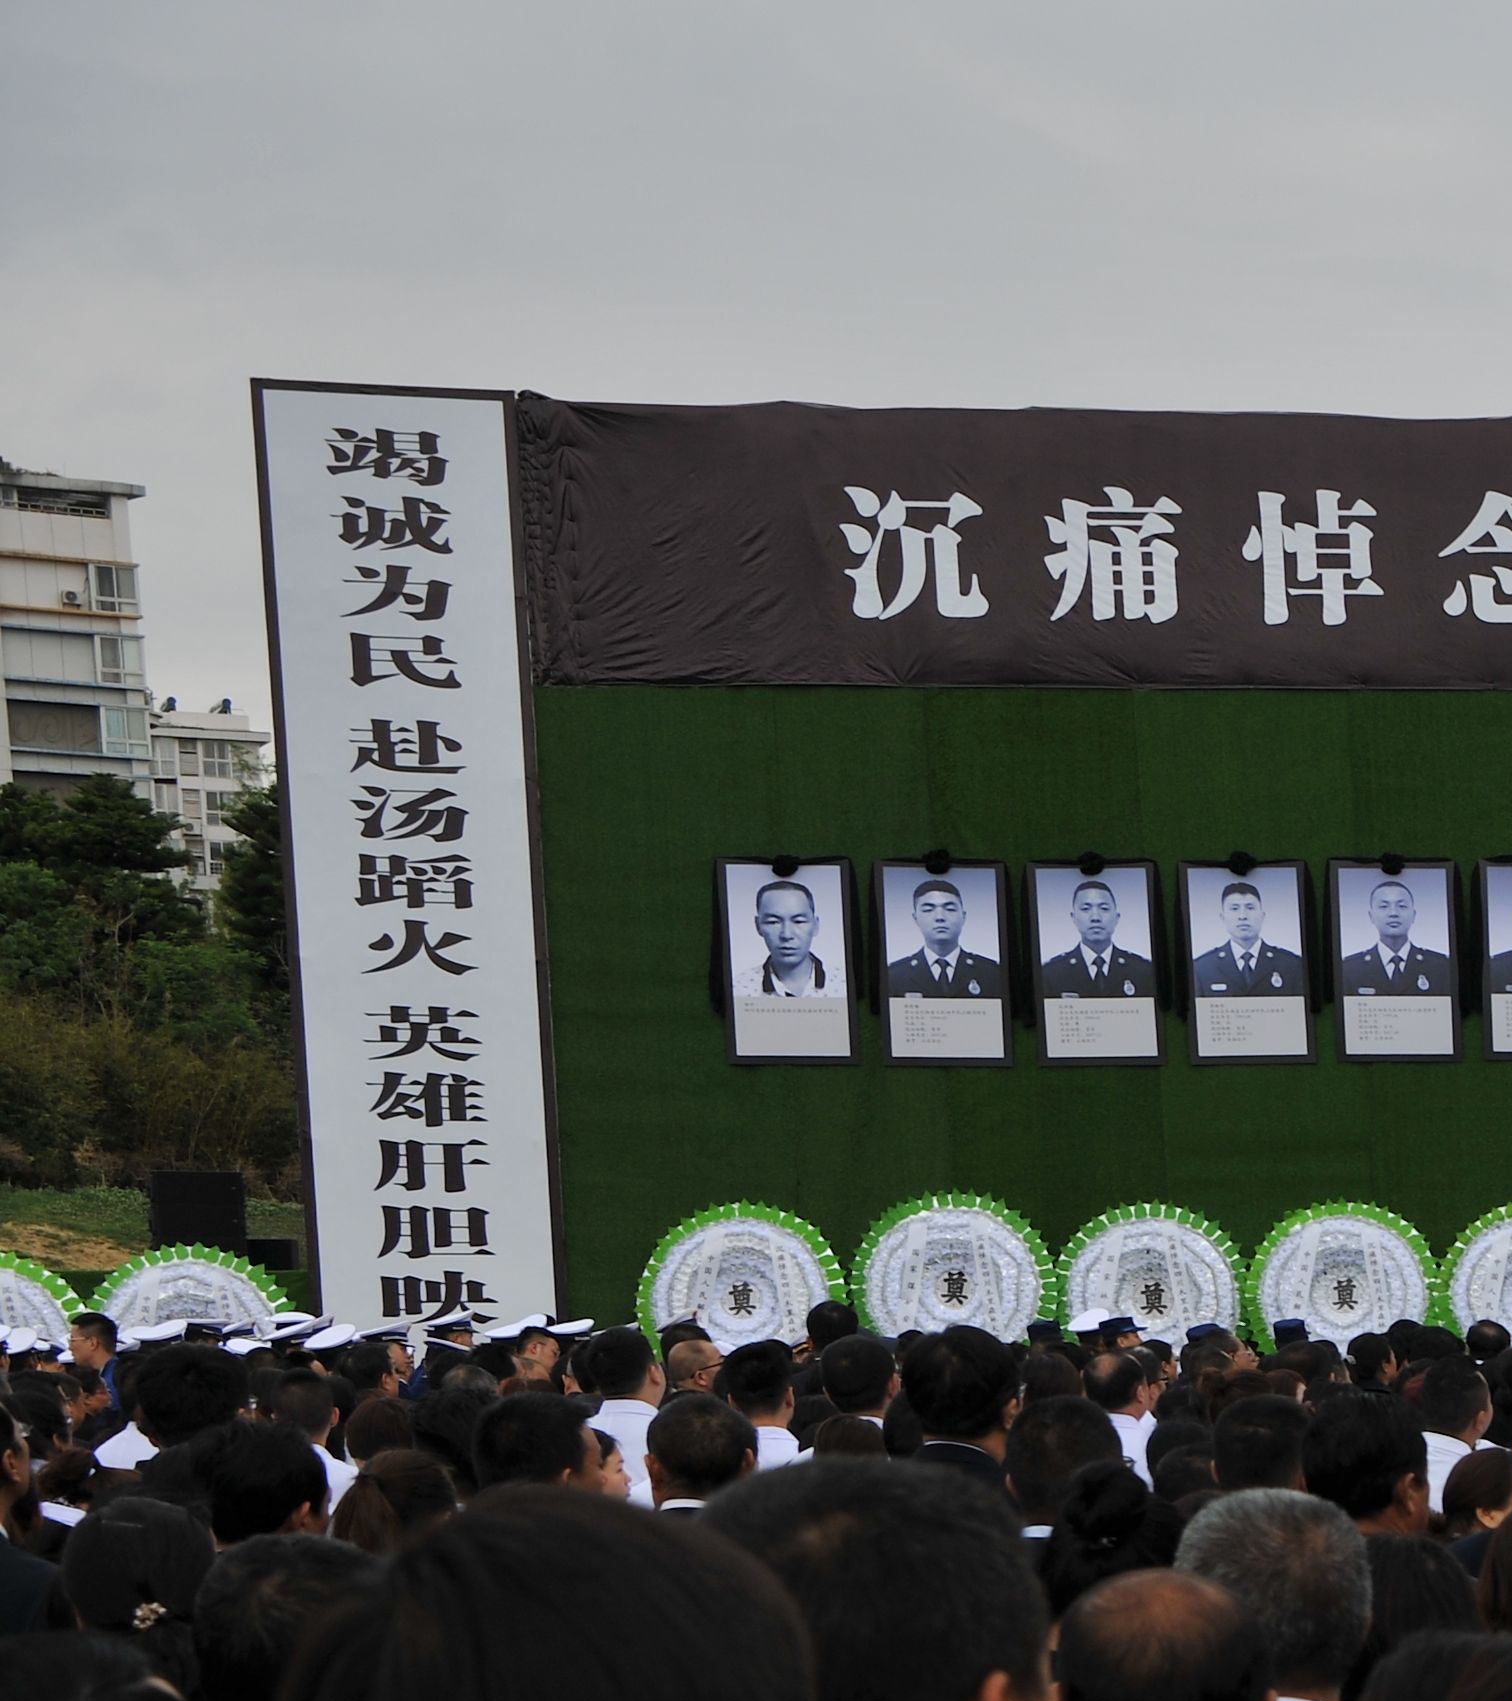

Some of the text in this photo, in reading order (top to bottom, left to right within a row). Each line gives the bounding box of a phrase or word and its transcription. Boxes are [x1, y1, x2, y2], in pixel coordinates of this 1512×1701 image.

[325, 428, 499, 1324] 竭诚为民 赴汤蹈火 英雄肝胆映
